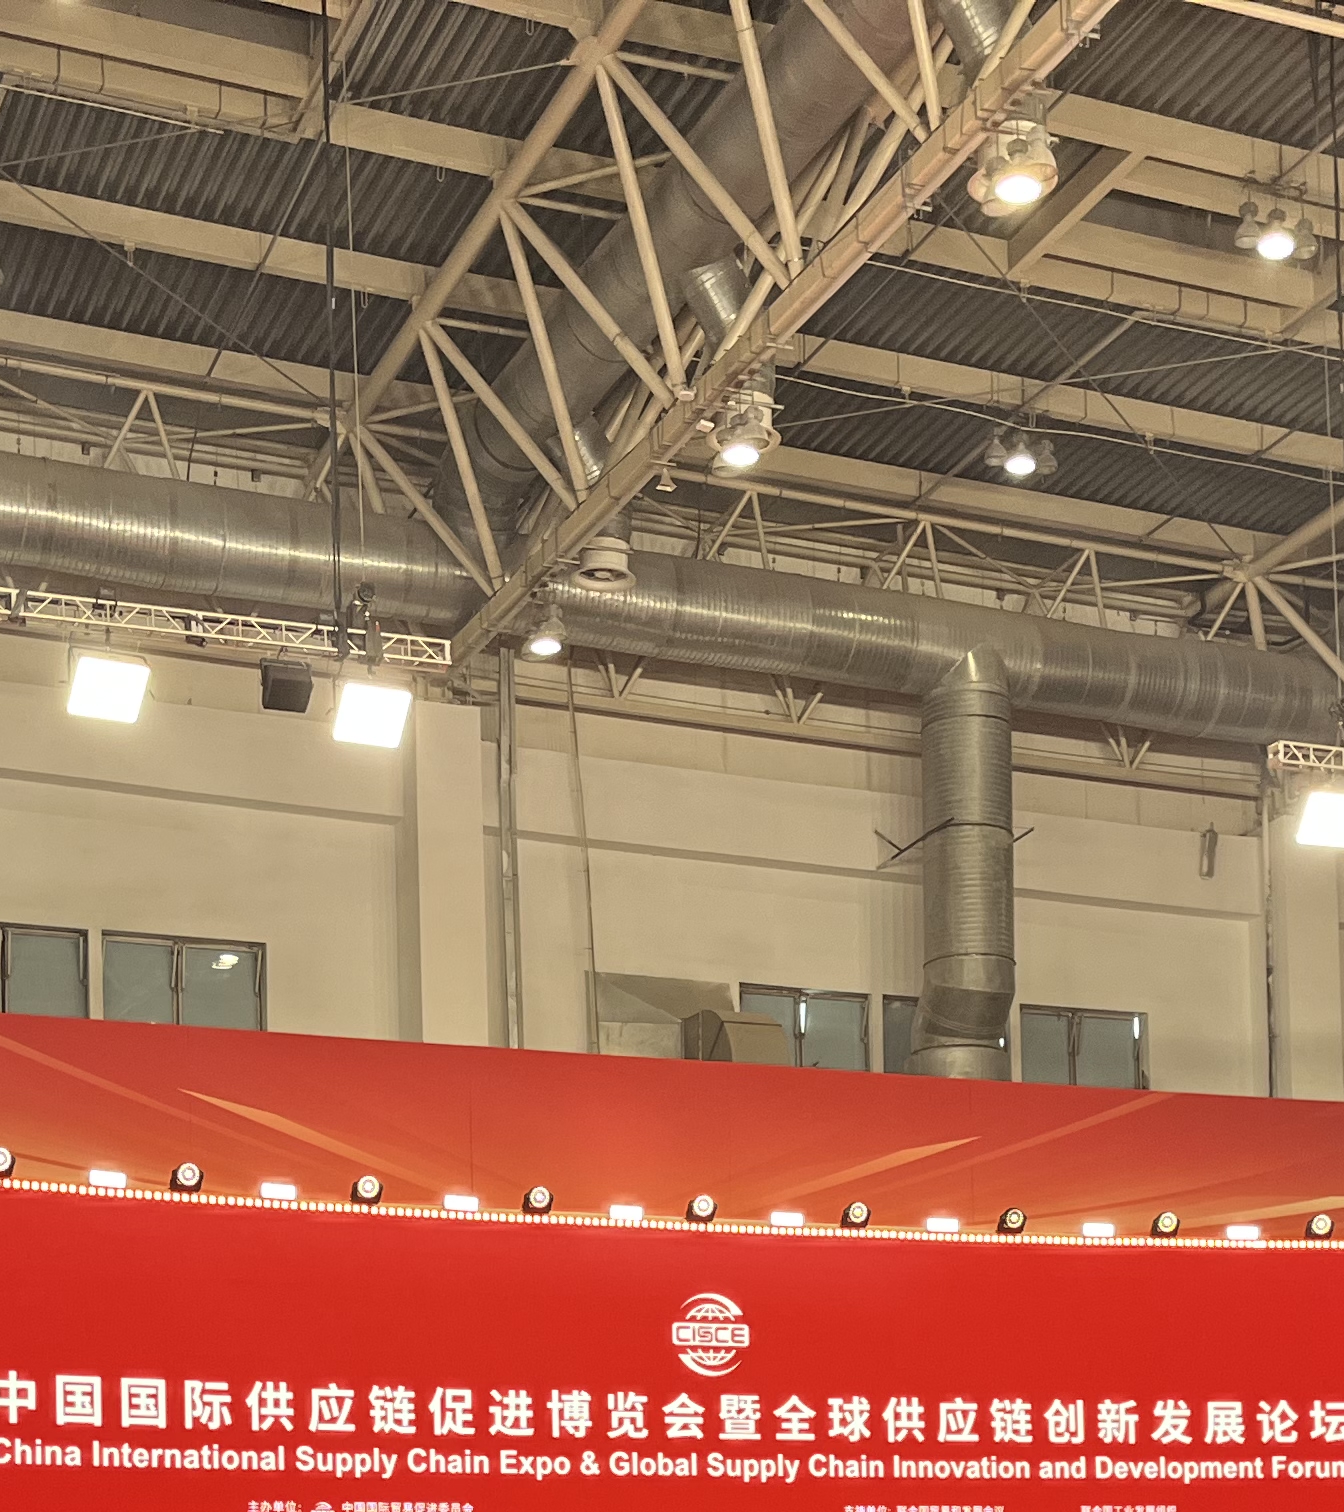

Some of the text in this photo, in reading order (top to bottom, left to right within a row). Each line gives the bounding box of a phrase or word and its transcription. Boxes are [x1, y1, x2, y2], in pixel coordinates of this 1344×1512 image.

[675, 1325, 746, 1344] CISCE
[92, 1441, 285, 1471] International
[295, 1446, 399, 1479] Supply
[406, 1447, 490, 1475] Chain
[499, 1449, 572, 1481] Expo
[579, 1450, 601, 1476] &
[608, 1450, 698, 1477] Global
[706, 1451, 801, 1484] Supply
[808, 1453, 885, 1478] Chain
[893, 1454, 1031, 1480] Innovation
[1038, 1455, 1087, 1479] and
[1094, 1455, 1265, 1485] Development
